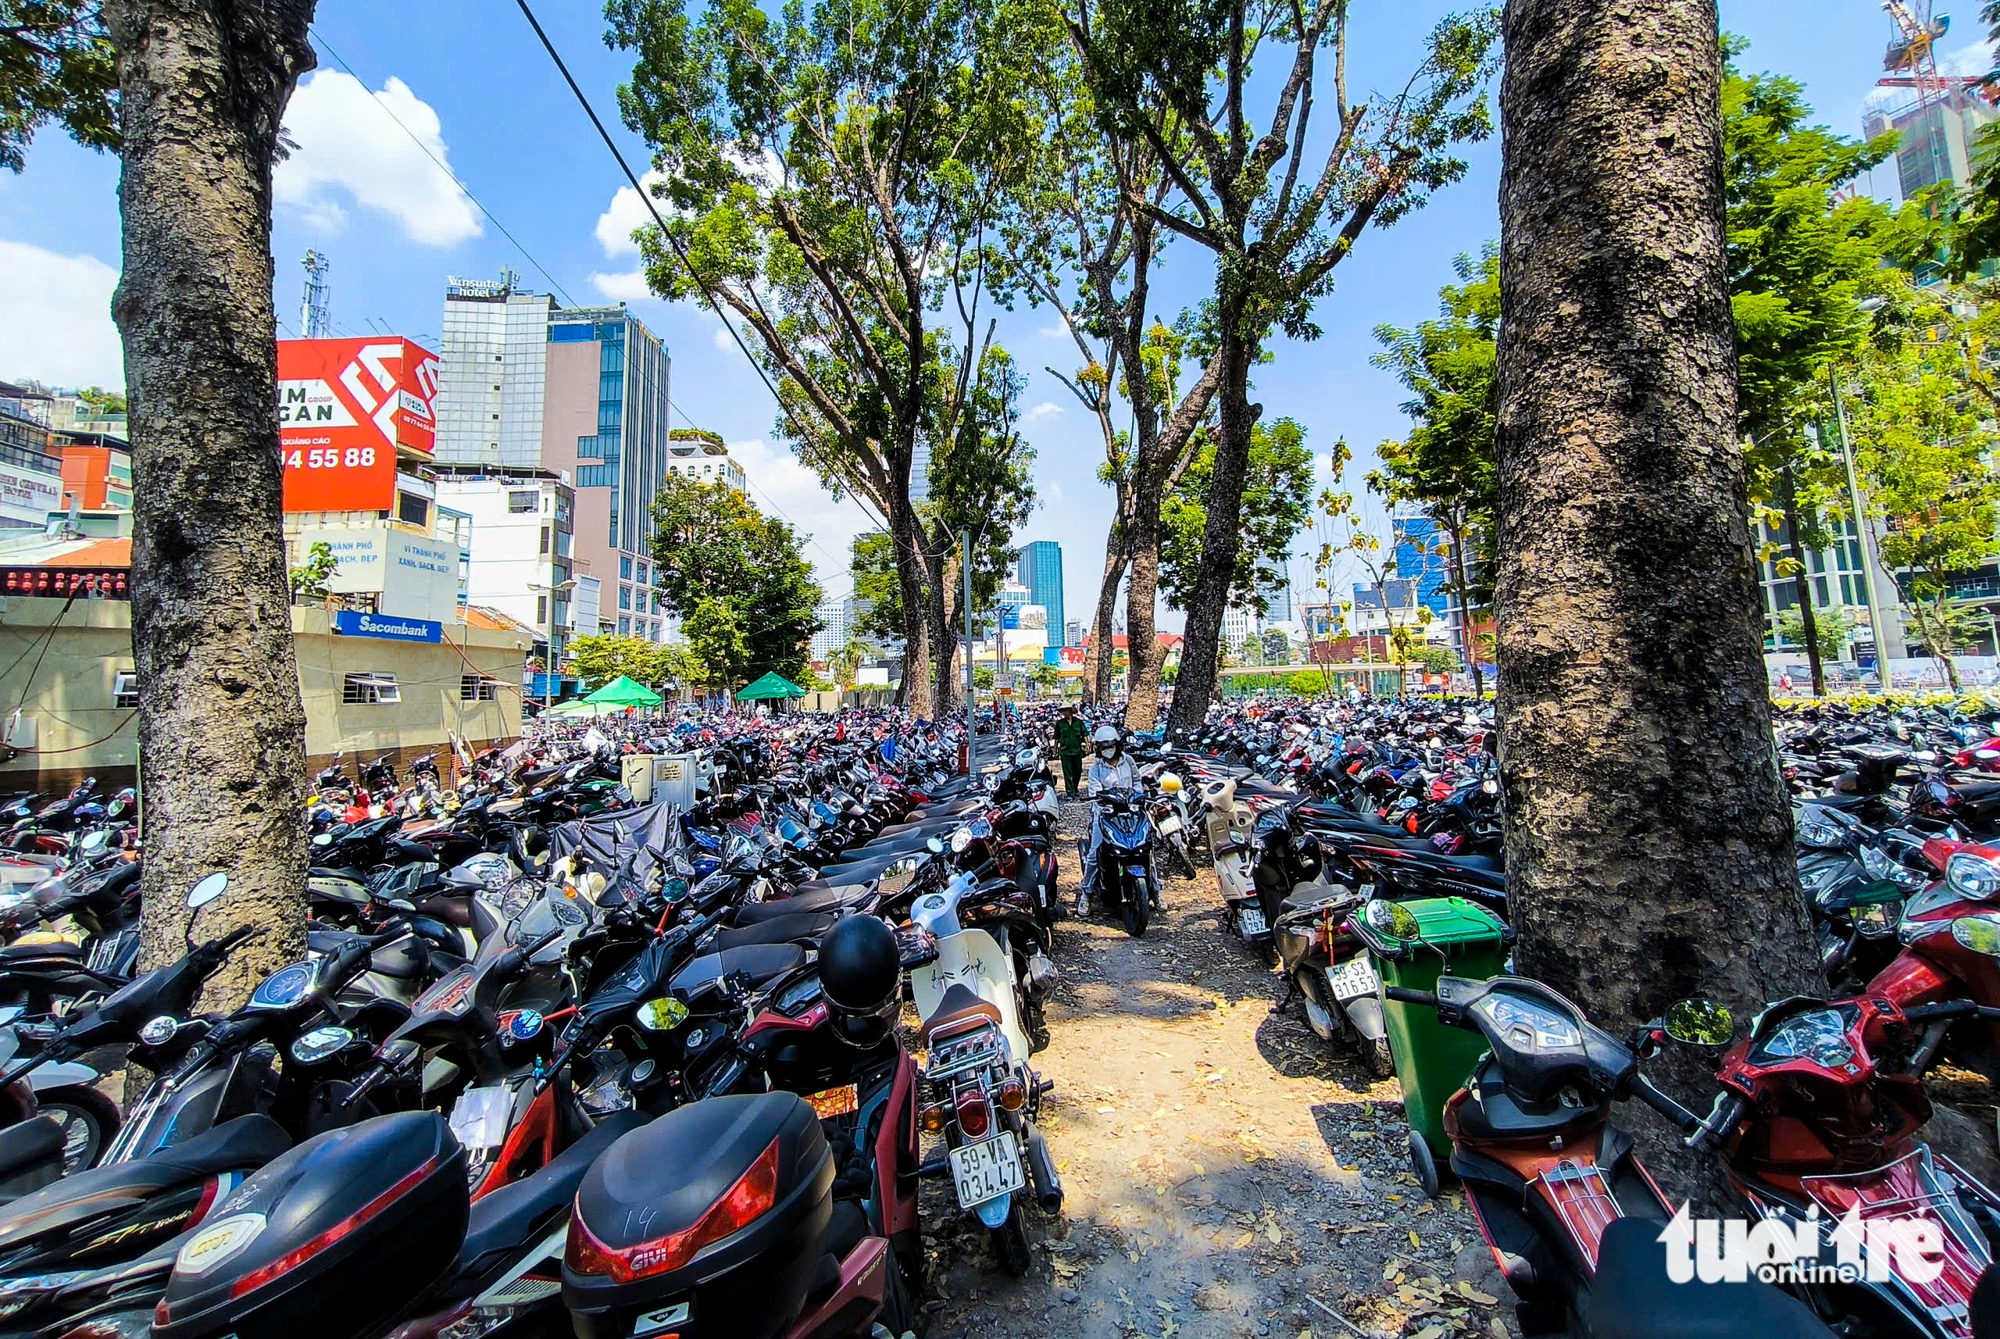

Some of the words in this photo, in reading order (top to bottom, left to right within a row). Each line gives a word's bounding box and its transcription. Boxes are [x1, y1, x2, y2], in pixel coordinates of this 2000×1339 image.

[459, 288, 490, 297] hotel
[278, 405, 333, 421] GAN
[308, 448, 339, 468] 55
[344, 448, 375, 467] 88
[359, 615, 428, 637] Sacombank
[1332, 961, 1366, 982] 59-S3
[1335, 975, 1376, 999] 316.53
[960, 1161, 1016, 1203] 034.47
[623, 1205, 657, 1239] 14
[630, 1248, 667, 1271] GIVI
